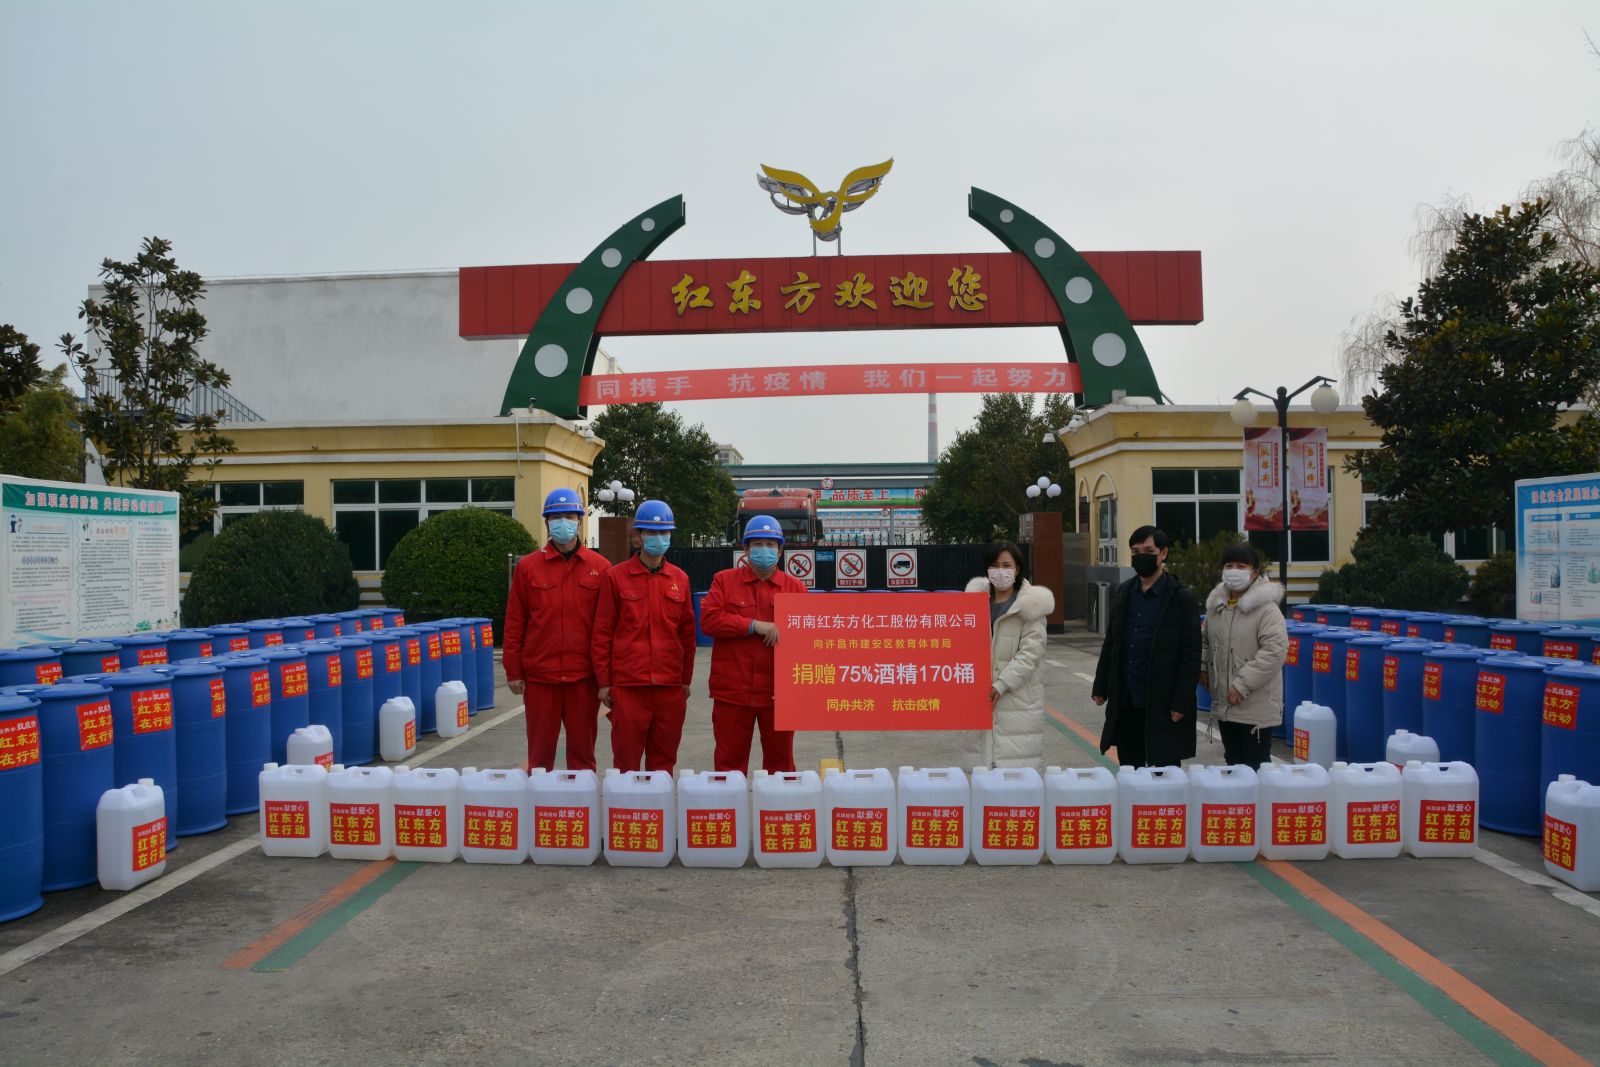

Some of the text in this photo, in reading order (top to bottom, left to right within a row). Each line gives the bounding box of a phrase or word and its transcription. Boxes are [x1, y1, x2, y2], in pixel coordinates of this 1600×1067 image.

[671, 265, 988, 315] 红东方欢迎您
[597, 367, 1067, 398] 同携手 抗疫情 我们一起努力
[25, 491, 98, 510] 加强职业病防治
[787, 614, 976, 629] 河南红东方化工股份有限公司
[813, 638, 952, 649] 向许昌市建安区教育体育局
[827, 698, 940, 712] 同舟共济 抗击疫情
[350, 806, 373, 814] 献爱心
[416, 808, 440, 816] 献爱心
[487, 809, 512, 818] 献爱心
[932, 809, 958, 817] 献爱心
[1009, 809, 1035, 817] 献爱心
[1082, 808, 1106, 816] 献爱心
[1298, 805, 1322, 813] 献爱心
[1372, 803, 1396, 812] 献爱心
[1447, 803, 1471, 811] 献爱心
[268, 812, 304, 823] 红东方
[632, 812, 657, 820] 献爱心
[785, 812, 810, 820] 献爱心
[856, 810, 882, 818] 献爱心
[1277, 814, 1322, 827] 红东方
[1352, 812, 1396, 826] 红东方
[1425, 812, 1471, 825] 红东方
[332, 815, 374, 828] 红东方
[398, 817, 440, 830] 红东方
[468, 817, 512, 832] 红东方
[539, 818, 583, 832] 红东方
[612, 820, 658, 835] 红东方
[691, 820, 730, 831] 红东方
[836, 820, 882, 833] 红东方
[911, 818, 958, 831] 红东方
[988, 818, 1035, 831] 红东方
[1061, 817, 1107, 831] 红东方
[1137, 817, 1182, 830] 红东方
[1206, 816, 1252, 828] 红东方
[269, 824, 304, 836] 在行动
[764, 822, 811, 835] 红东方
[1352, 827, 1396, 841] 在行动
[1424, 826, 1470, 840] 在行动
[333, 828, 375, 843] 在行动
[398, 830, 441, 846] 在行动
[467, 831, 512, 848] 在行动
[538, 832, 584, 847] 在行动
[612, 834, 657, 850] 在行动
[691, 833, 731, 845] 在行动
[835, 834, 882, 848] 在行动
[911, 832, 958, 847] 在行动
[987, 833, 1034, 847] 在行动
[1060, 832, 1107, 846] 在行动
[1136, 832, 1182, 845] 在行动
[1206, 830, 1251, 844] 在行动
[1276, 829, 1322, 842] 在行动
[765, 837, 811, 850] 在行动
